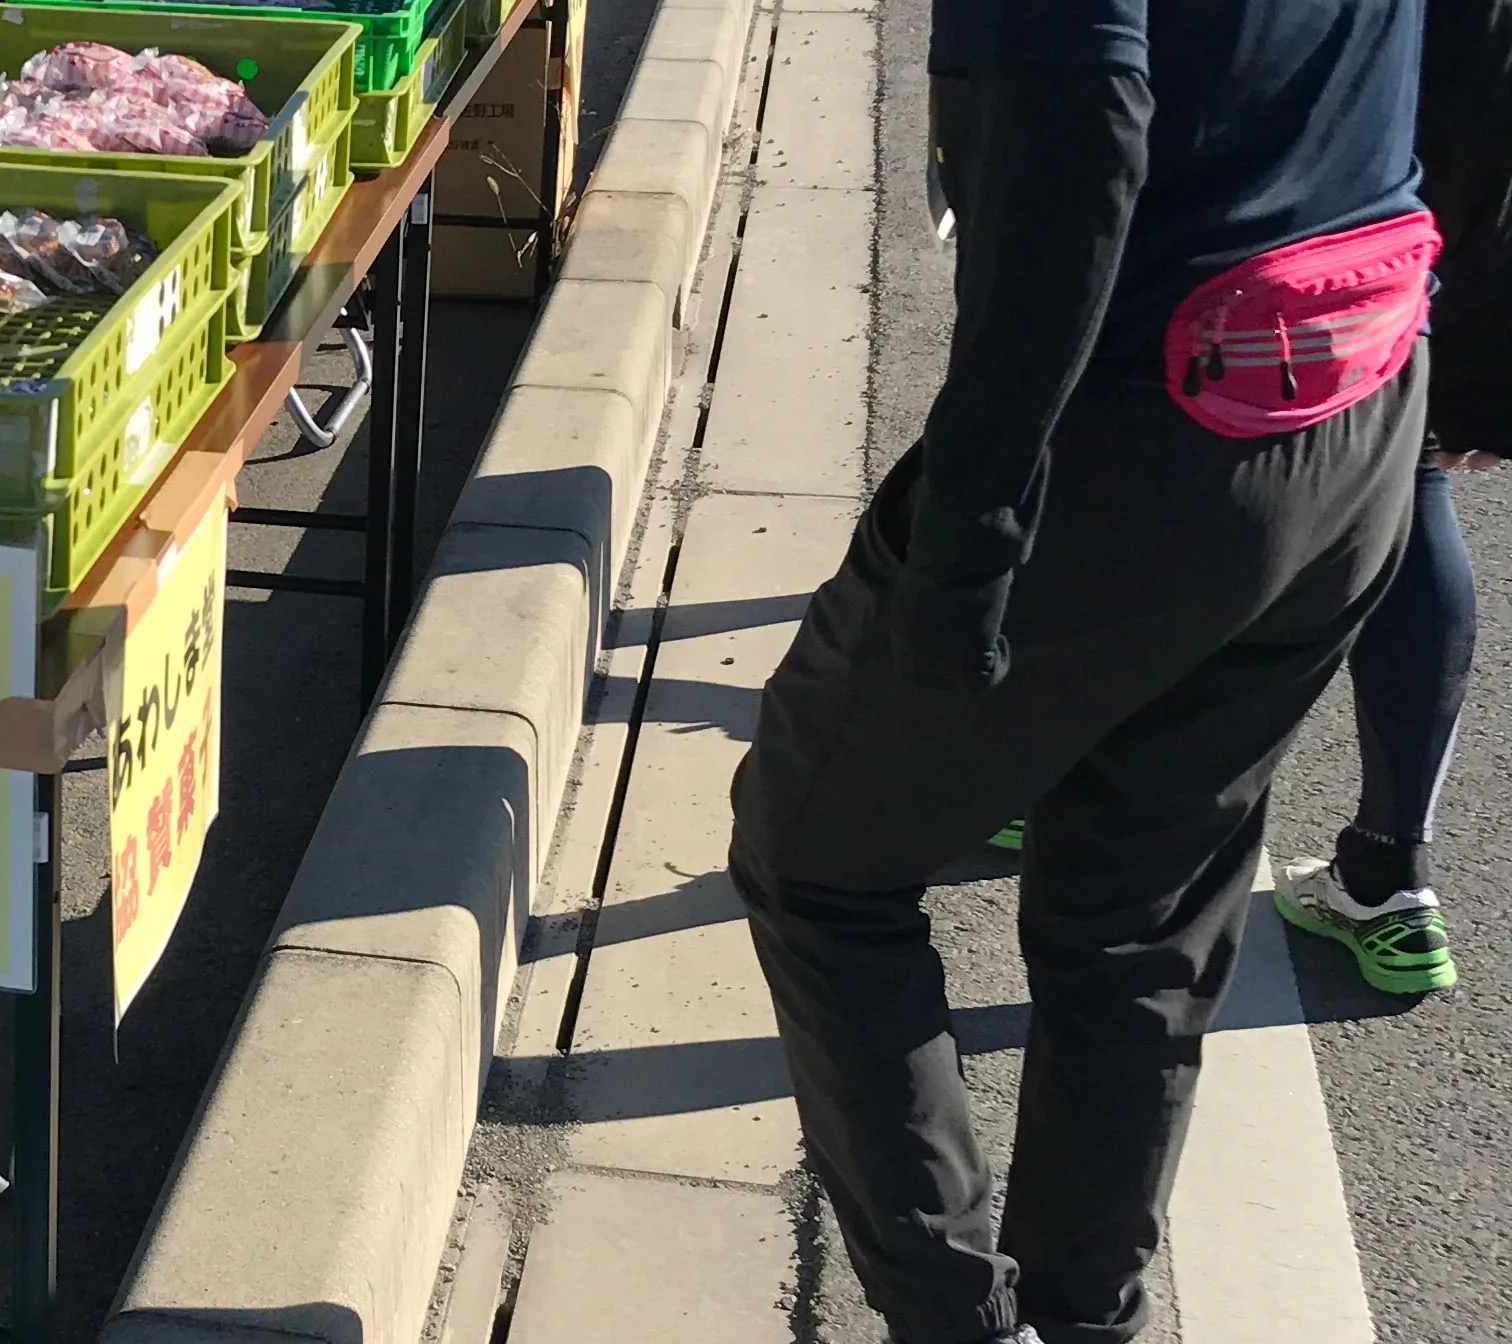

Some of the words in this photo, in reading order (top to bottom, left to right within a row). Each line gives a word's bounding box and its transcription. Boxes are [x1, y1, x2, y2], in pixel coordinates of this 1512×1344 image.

[111, 569, 215, 811] あわしま堂
[113, 685, 212, 942] 協賛菓子
